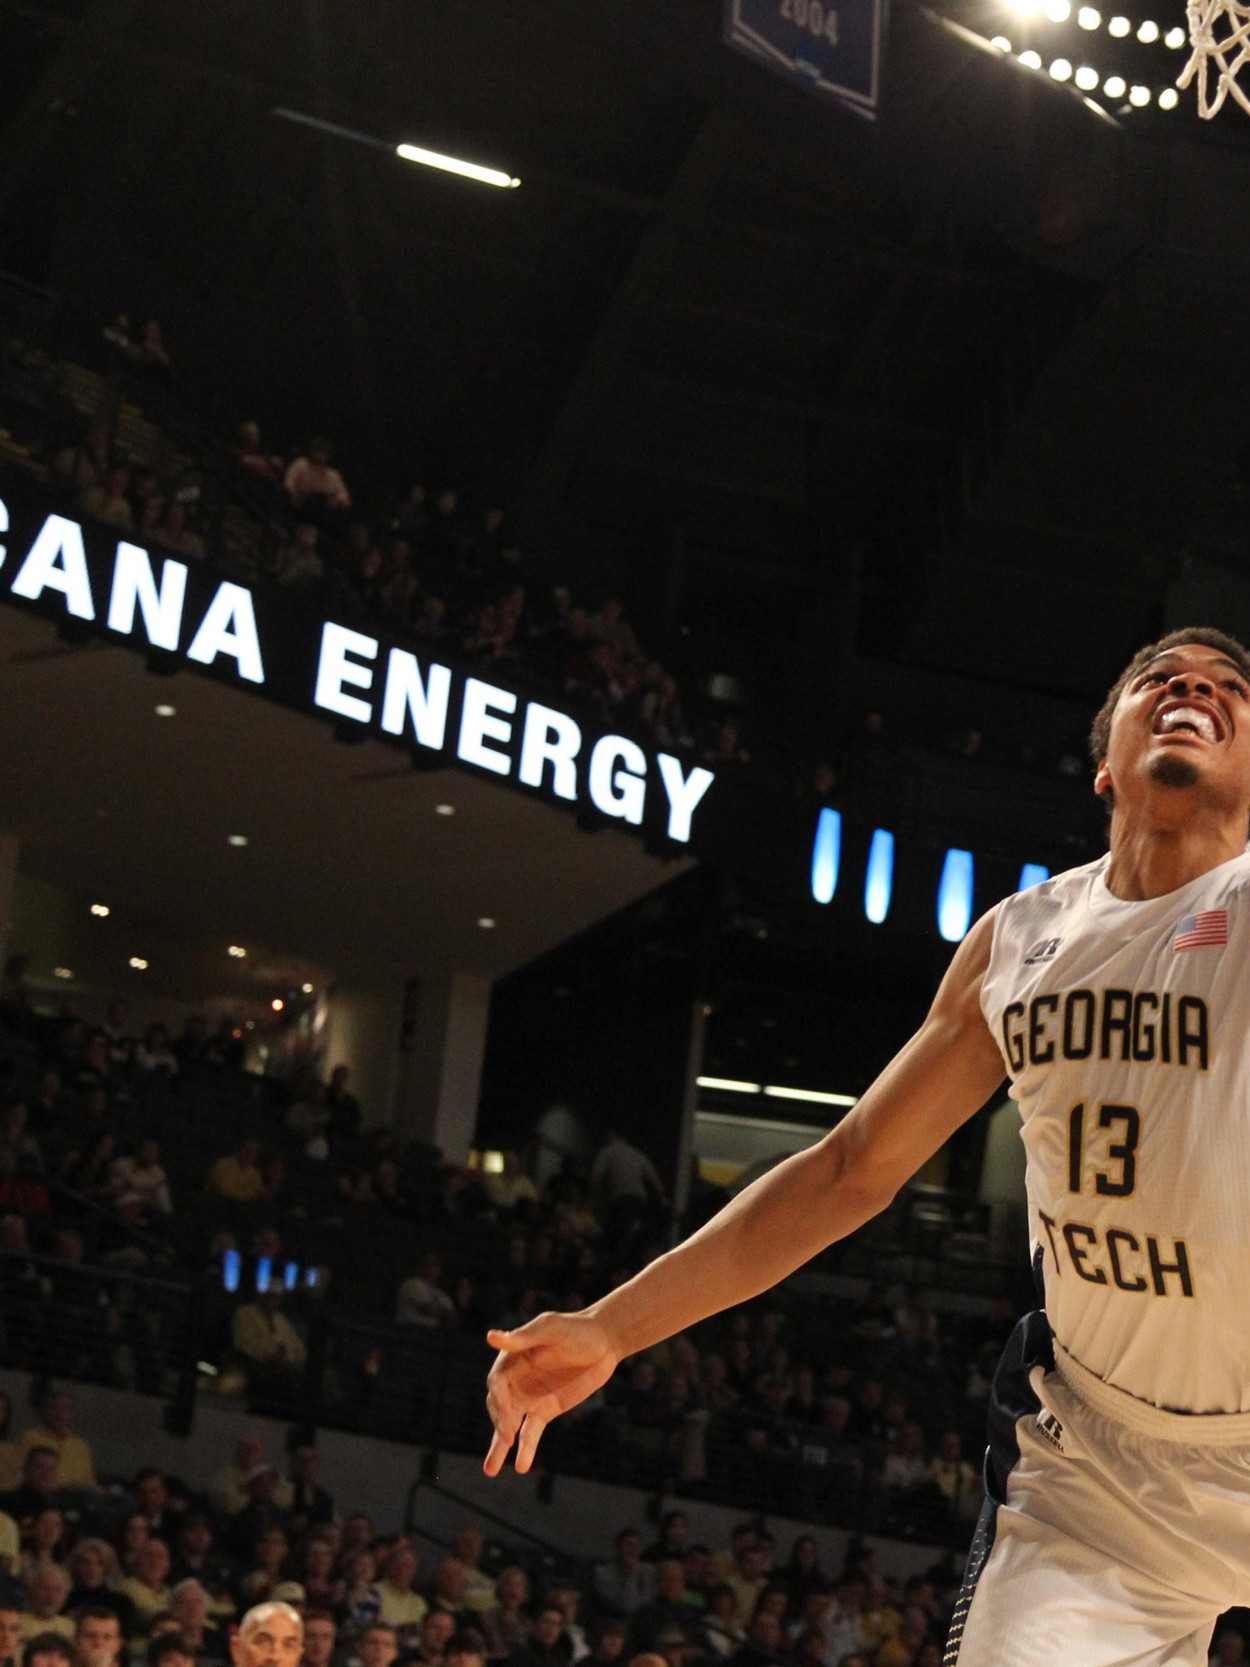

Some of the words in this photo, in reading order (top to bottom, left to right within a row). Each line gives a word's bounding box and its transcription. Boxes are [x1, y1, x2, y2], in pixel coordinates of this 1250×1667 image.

[0, 498, 265, 684] ANA
[314, 621, 715, 843] ENERGY
[1001, 989, 1210, 1074] GEORGIA
[1066, 1101, 1142, 1198] 13
[1038, 1207, 1195, 1298] TECH
